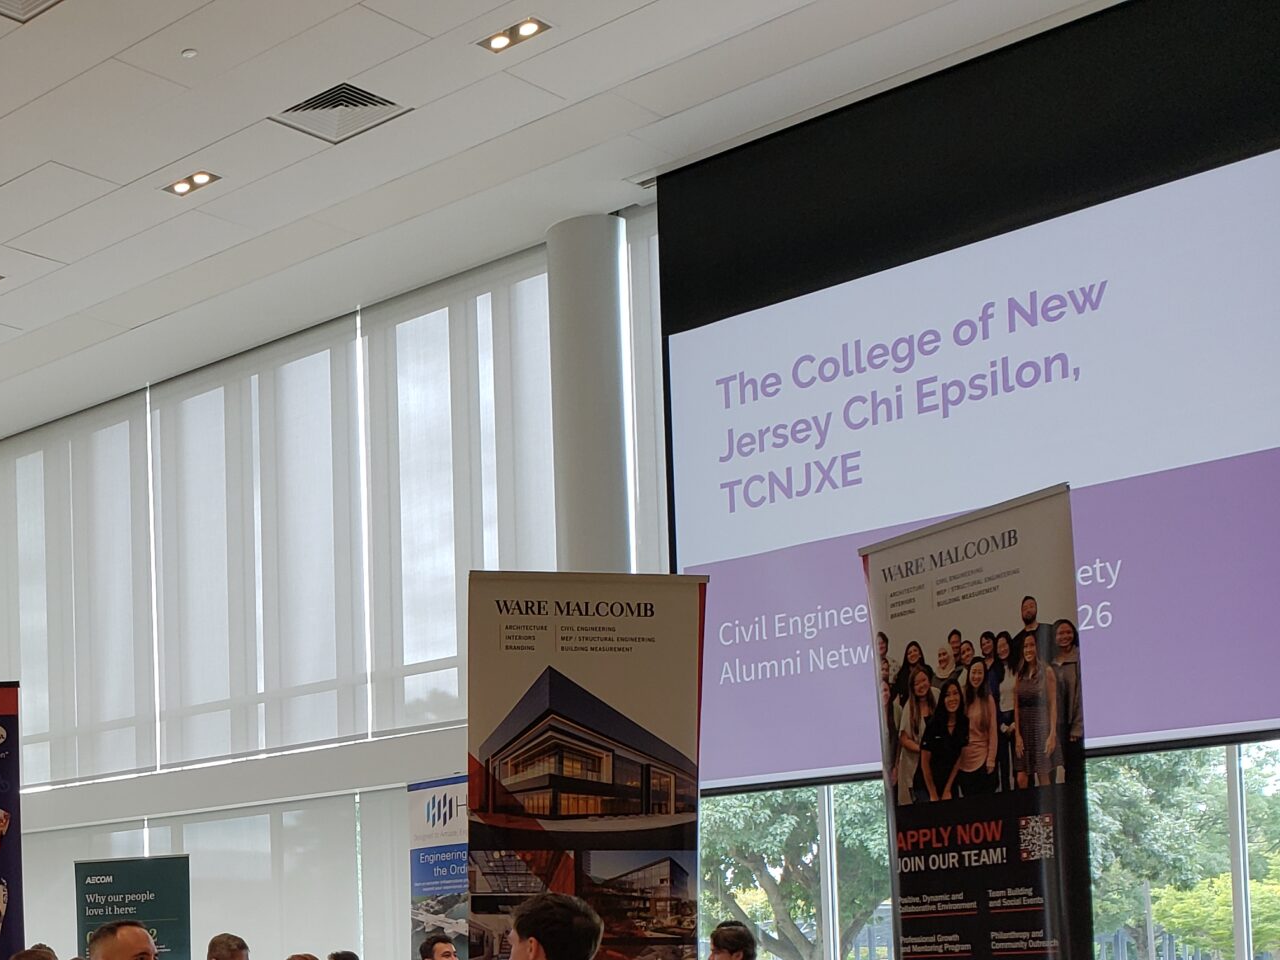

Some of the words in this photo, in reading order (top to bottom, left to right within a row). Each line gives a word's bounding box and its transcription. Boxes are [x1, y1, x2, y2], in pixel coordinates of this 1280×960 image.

[715, 371, 782, 410] The
[791, 328, 941, 389] College
[952, 301, 996, 347] of
[1007, 279, 1108, 334] New
[719, 412, 832, 463] Jersey
[843, 384, 904, 431] Chi
[916, 351, 1081, 419] Epsilon,
[719, 450, 863, 514] TCNJXE
[881, 556, 925, 583] WARE
[929, 529, 1018, 571] MALCOMB
[890, 583, 925, 598] ARCHITECTURE
[495, 600, 549, 616] WARE
[553, 600, 655, 618] MALCOMB
[1078, 600, 1113, 632] 26
[719, 612, 768, 646] Civil
[775, 602, 868, 640] Enginee
[719, 650, 801, 685] Alumni
[897, 826, 952, 851] APPLY
[956, 820, 1003, 846] NOW
[420, 850, 467, 864] Engineering
[897, 855, 925, 873] JOIN
[929, 851, 959, 870] OUR
[962, 847, 1007, 867] TEAM!
[433, 865, 447, 876] the
[85, 875, 113, 884] AECOM
[85, 893, 106, 904] Why
[125, 891, 155, 903] people
[922, 894, 950, 905] Dynamic
[951, 892, 964, 900] and
[988, 889, 1006, 898] Team
[1007, 886, 1033, 898] Building
[937, 901, 977, 911] Environment
[989, 898, 1001, 907] and
[1002, 897, 1021, 907] Social
[1022, 896, 1044, 905] Events
[85, 906, 104, 916] love
[105, 906, 112, 915] it
[114, 904, 137, 915] here:
[937, 933, 960, 943] Growth
[991, 930, 1030, 941] Philanthropy
[1031, 929, 1044, 938] and
[912, 943, 944, 954] Mentoring
[944, 943, 972, 953] Program
[991, 940, 1027, 950] Community
[1028, 939, 1059, 948] Outreach
